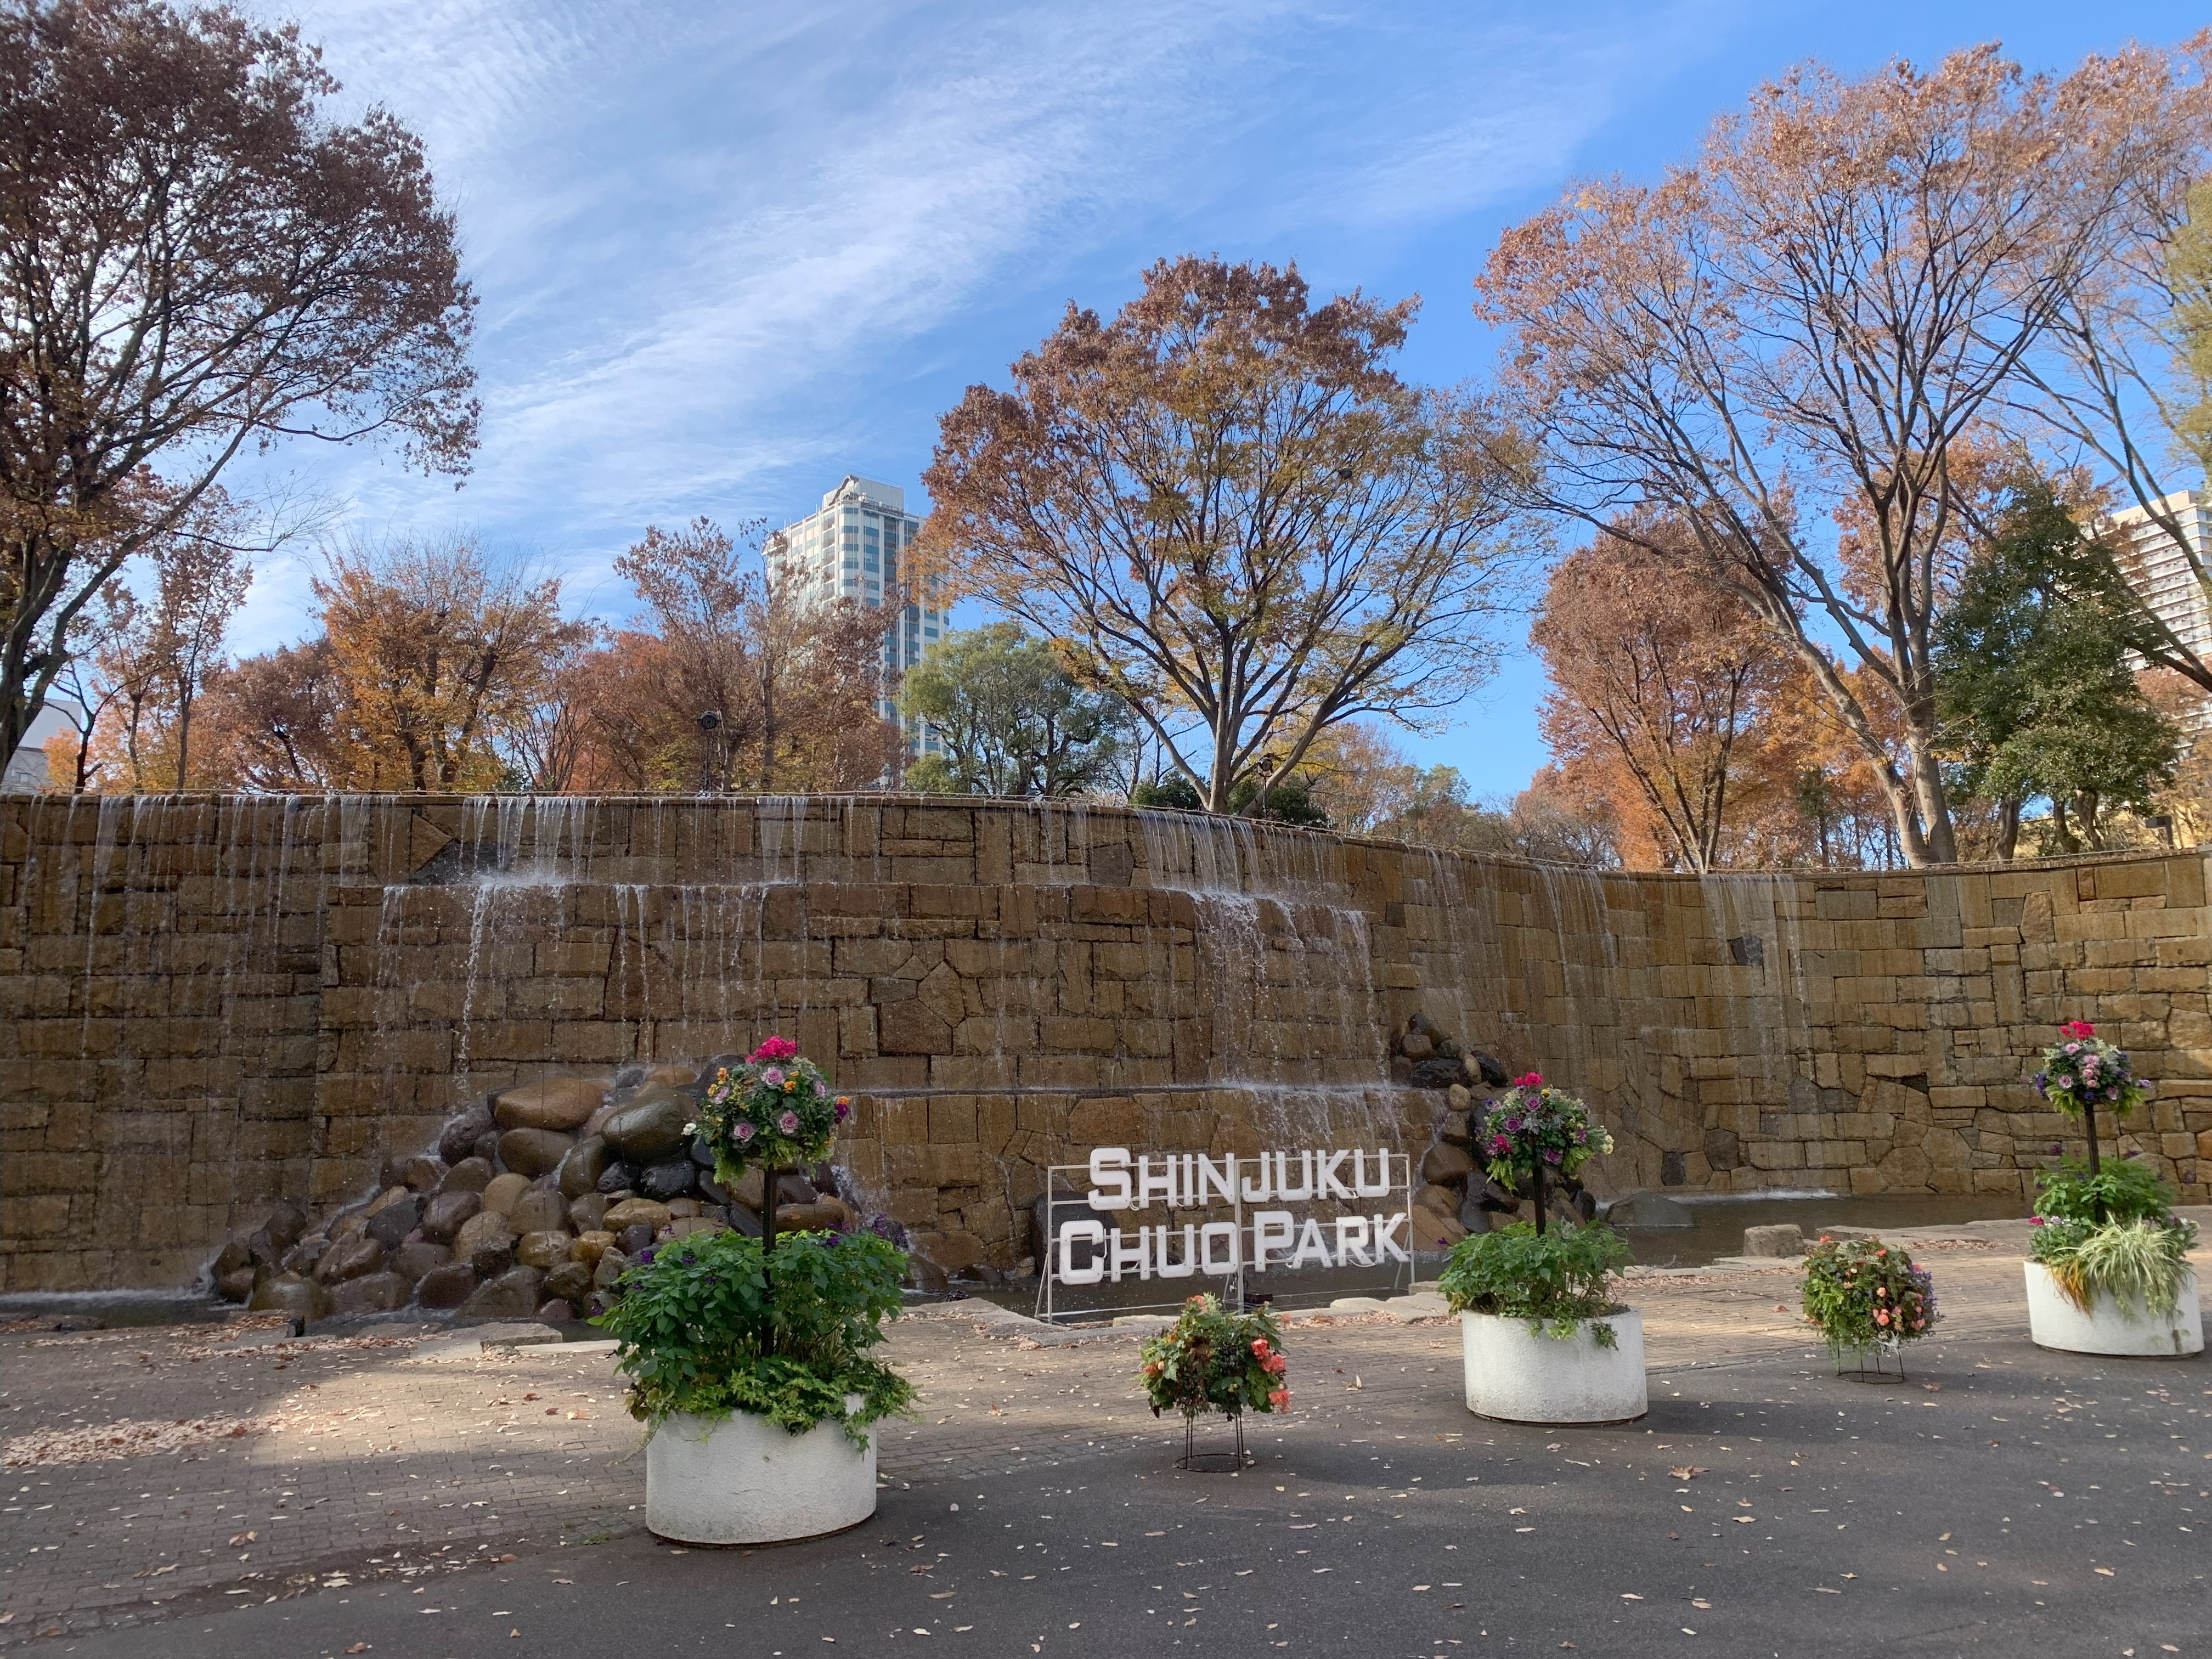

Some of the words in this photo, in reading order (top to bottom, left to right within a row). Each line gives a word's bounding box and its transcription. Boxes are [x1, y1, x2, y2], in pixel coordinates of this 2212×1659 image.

[1088, 1147, 1391, 1211] SHINJUKU
[1059, 1220, 1238, 1285] CHUO
[1253, 1210, 1410, 1272] PARK
